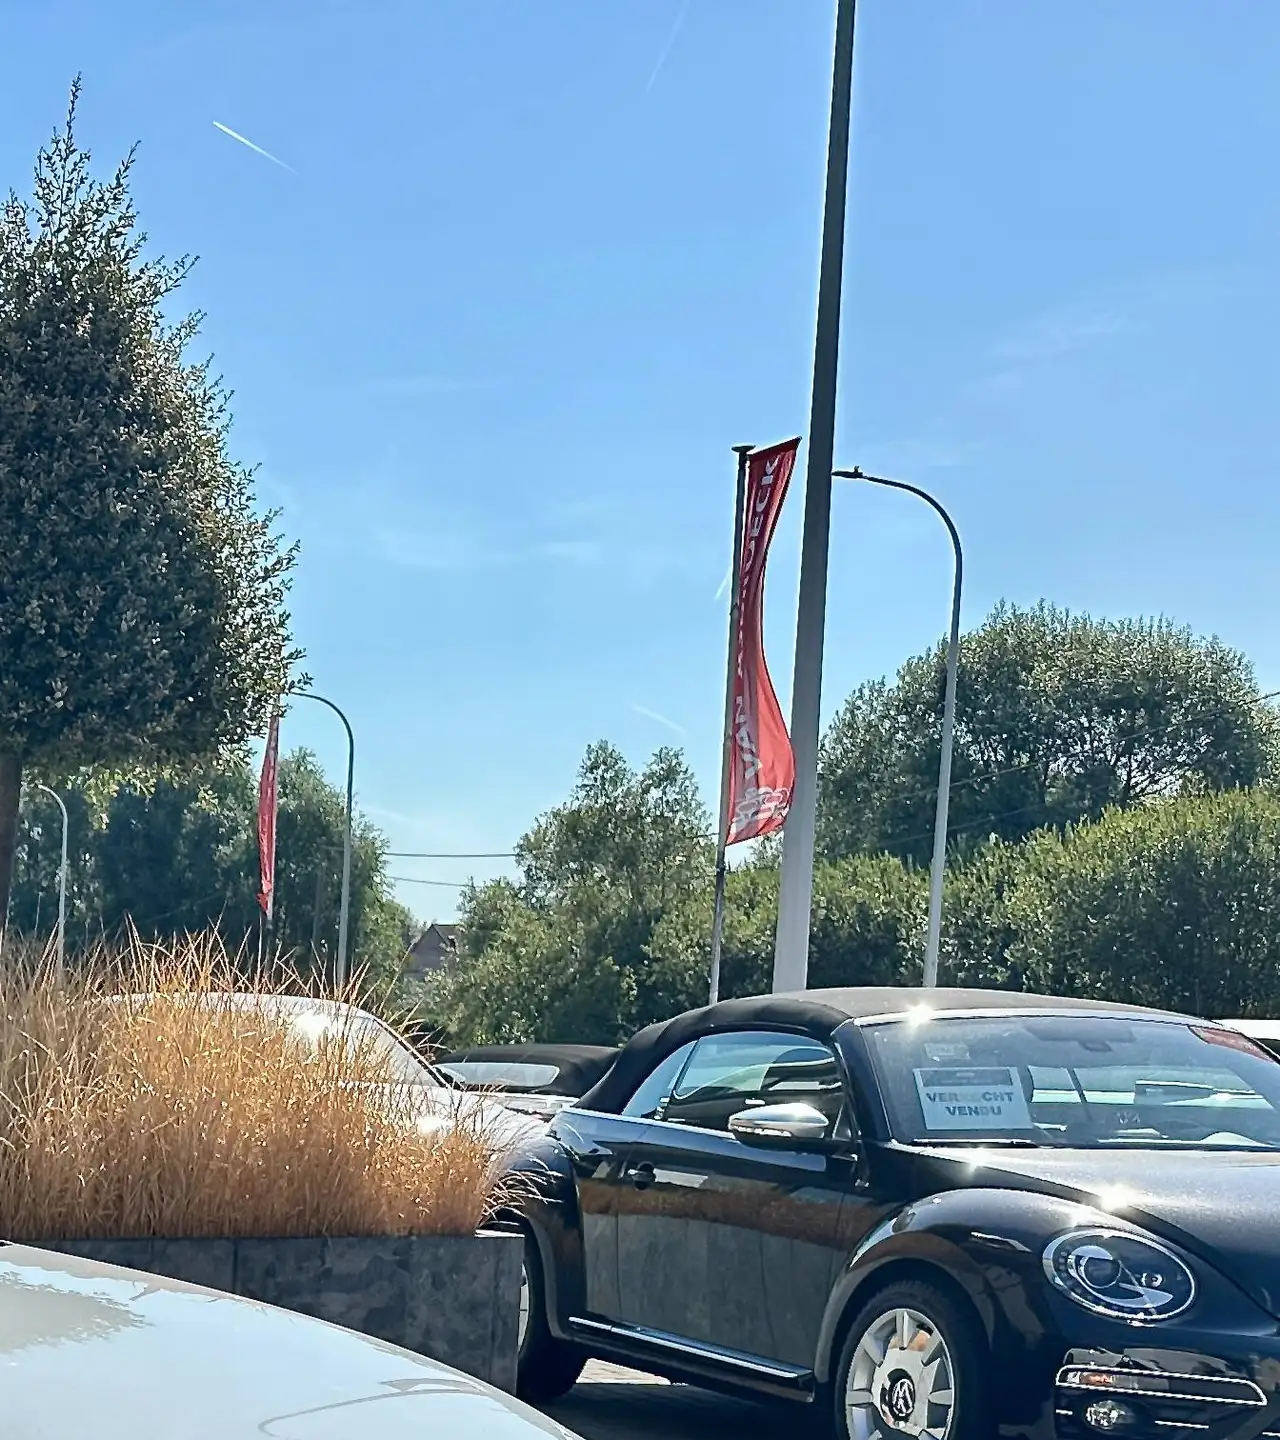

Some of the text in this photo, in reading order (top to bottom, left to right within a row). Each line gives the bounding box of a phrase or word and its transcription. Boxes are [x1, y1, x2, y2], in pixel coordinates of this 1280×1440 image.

[735, 454, 781, 779] VAN AOECK
[925, 1091, 1014, 1103] VERCHT
[944, 1105, 1002, 1117] VENDU
